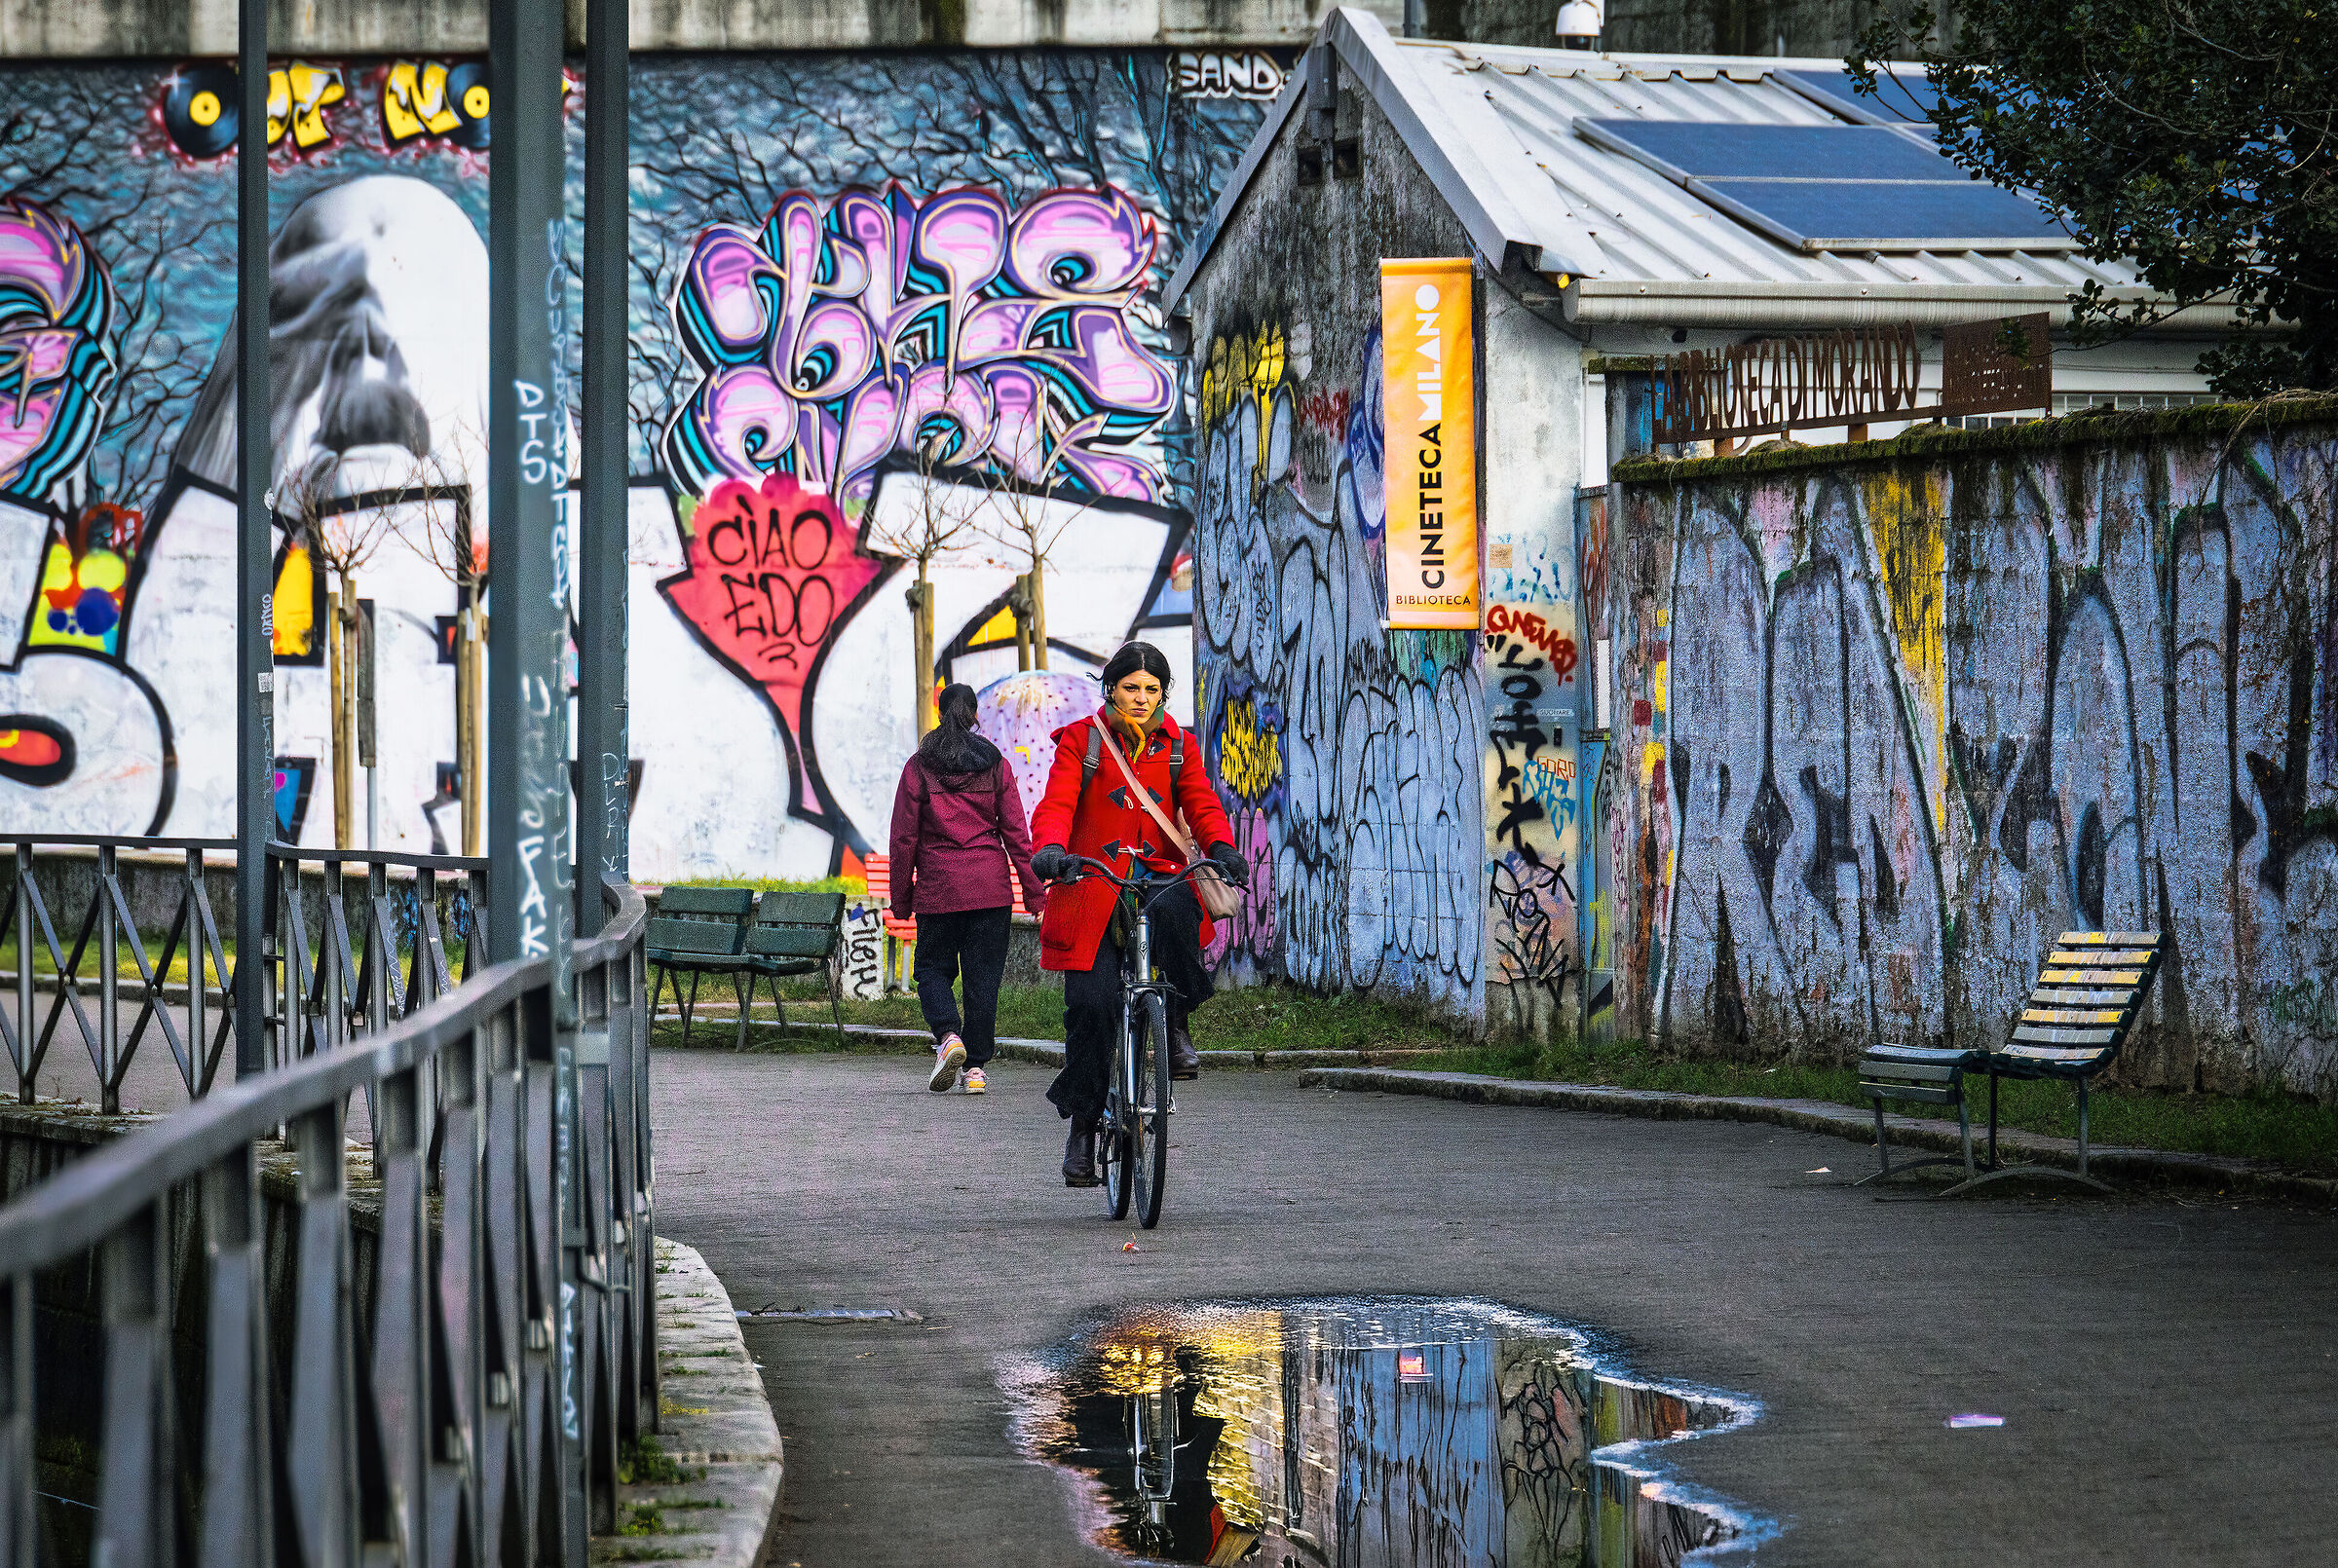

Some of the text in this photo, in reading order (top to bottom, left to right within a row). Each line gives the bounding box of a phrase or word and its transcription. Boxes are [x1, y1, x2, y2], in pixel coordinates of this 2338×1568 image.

[1414, 284, 1445, 588] CINETECA MILANO
[721, 572, 834, 647] EDO
[1396, 595, 1471, 606] BIBLIOTECA
